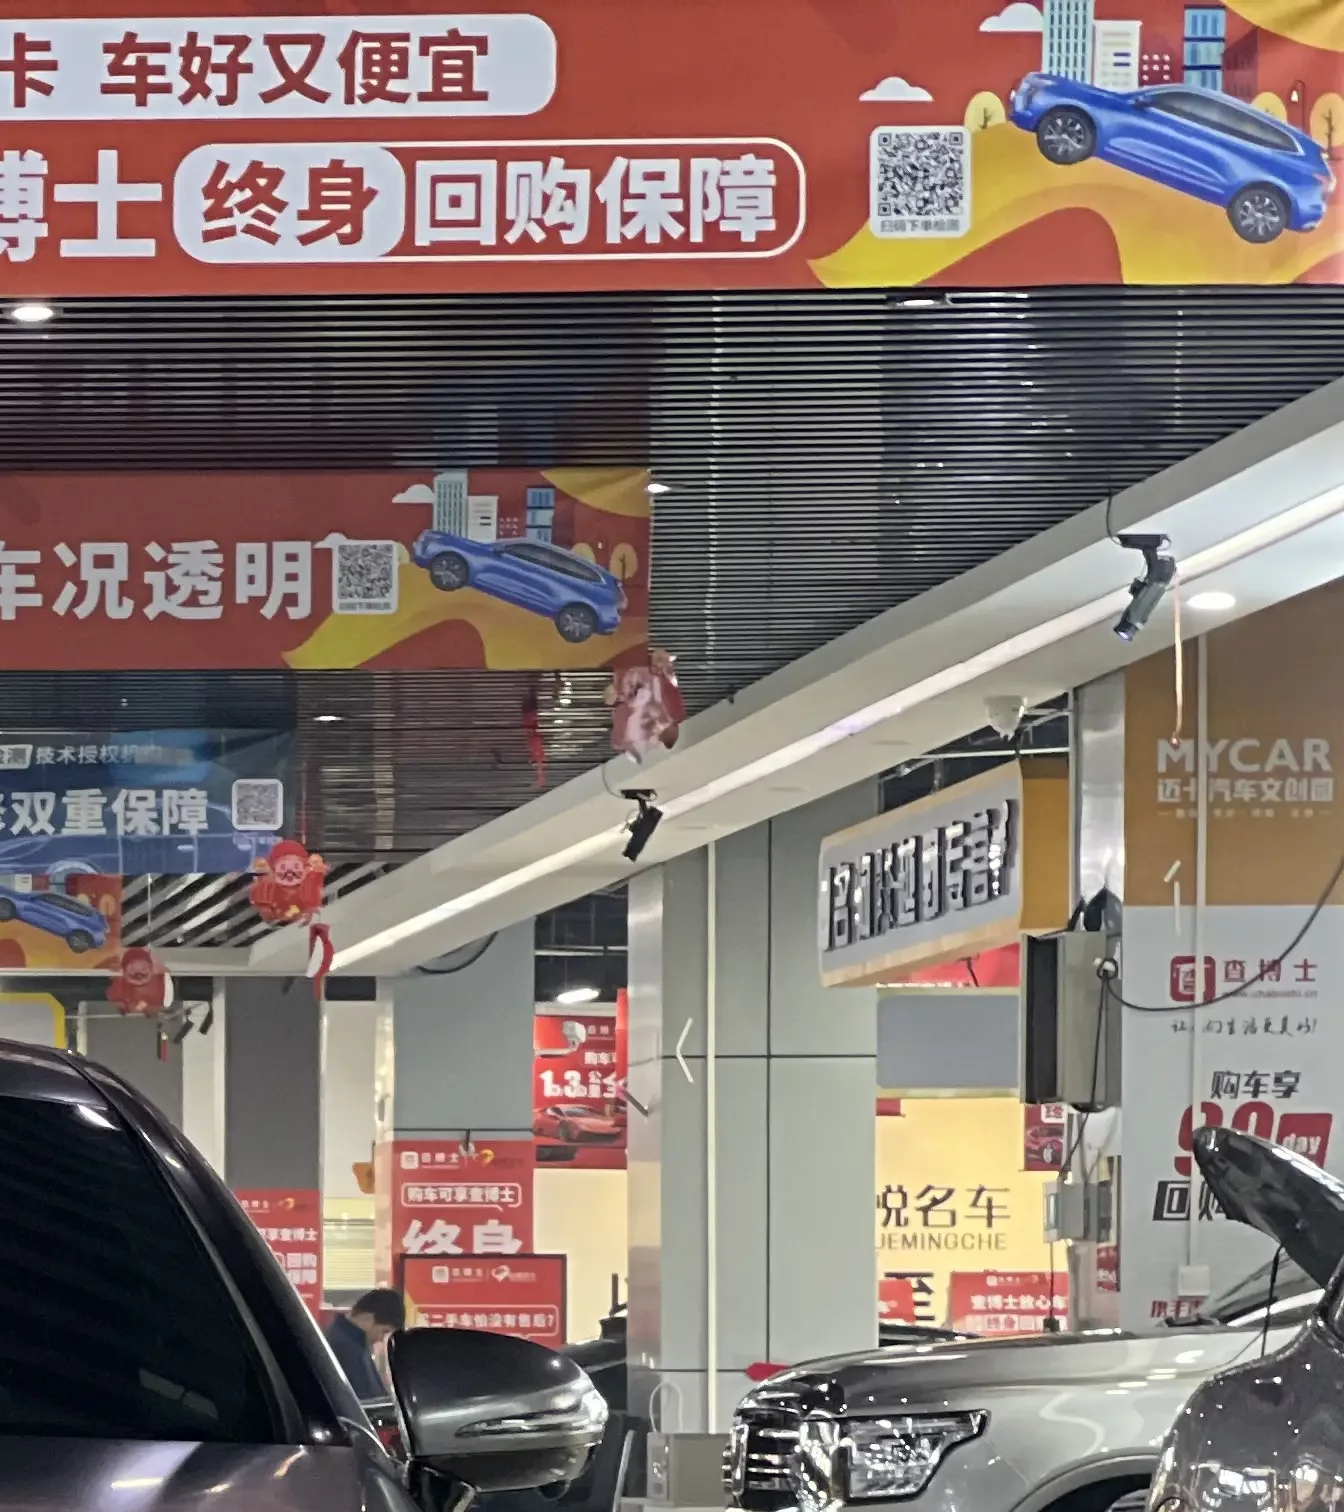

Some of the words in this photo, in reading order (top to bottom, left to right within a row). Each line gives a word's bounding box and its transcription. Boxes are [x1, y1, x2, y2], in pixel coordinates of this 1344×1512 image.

[100, 29, 489, 106] 车好又便宜
[200, 158, 380, 246] 终身
[414, 154, 778, 246] 回购保障
[1223, 958, 1319, 983] 查博士
[1210, 1070, 1302, 1100] 购车享
